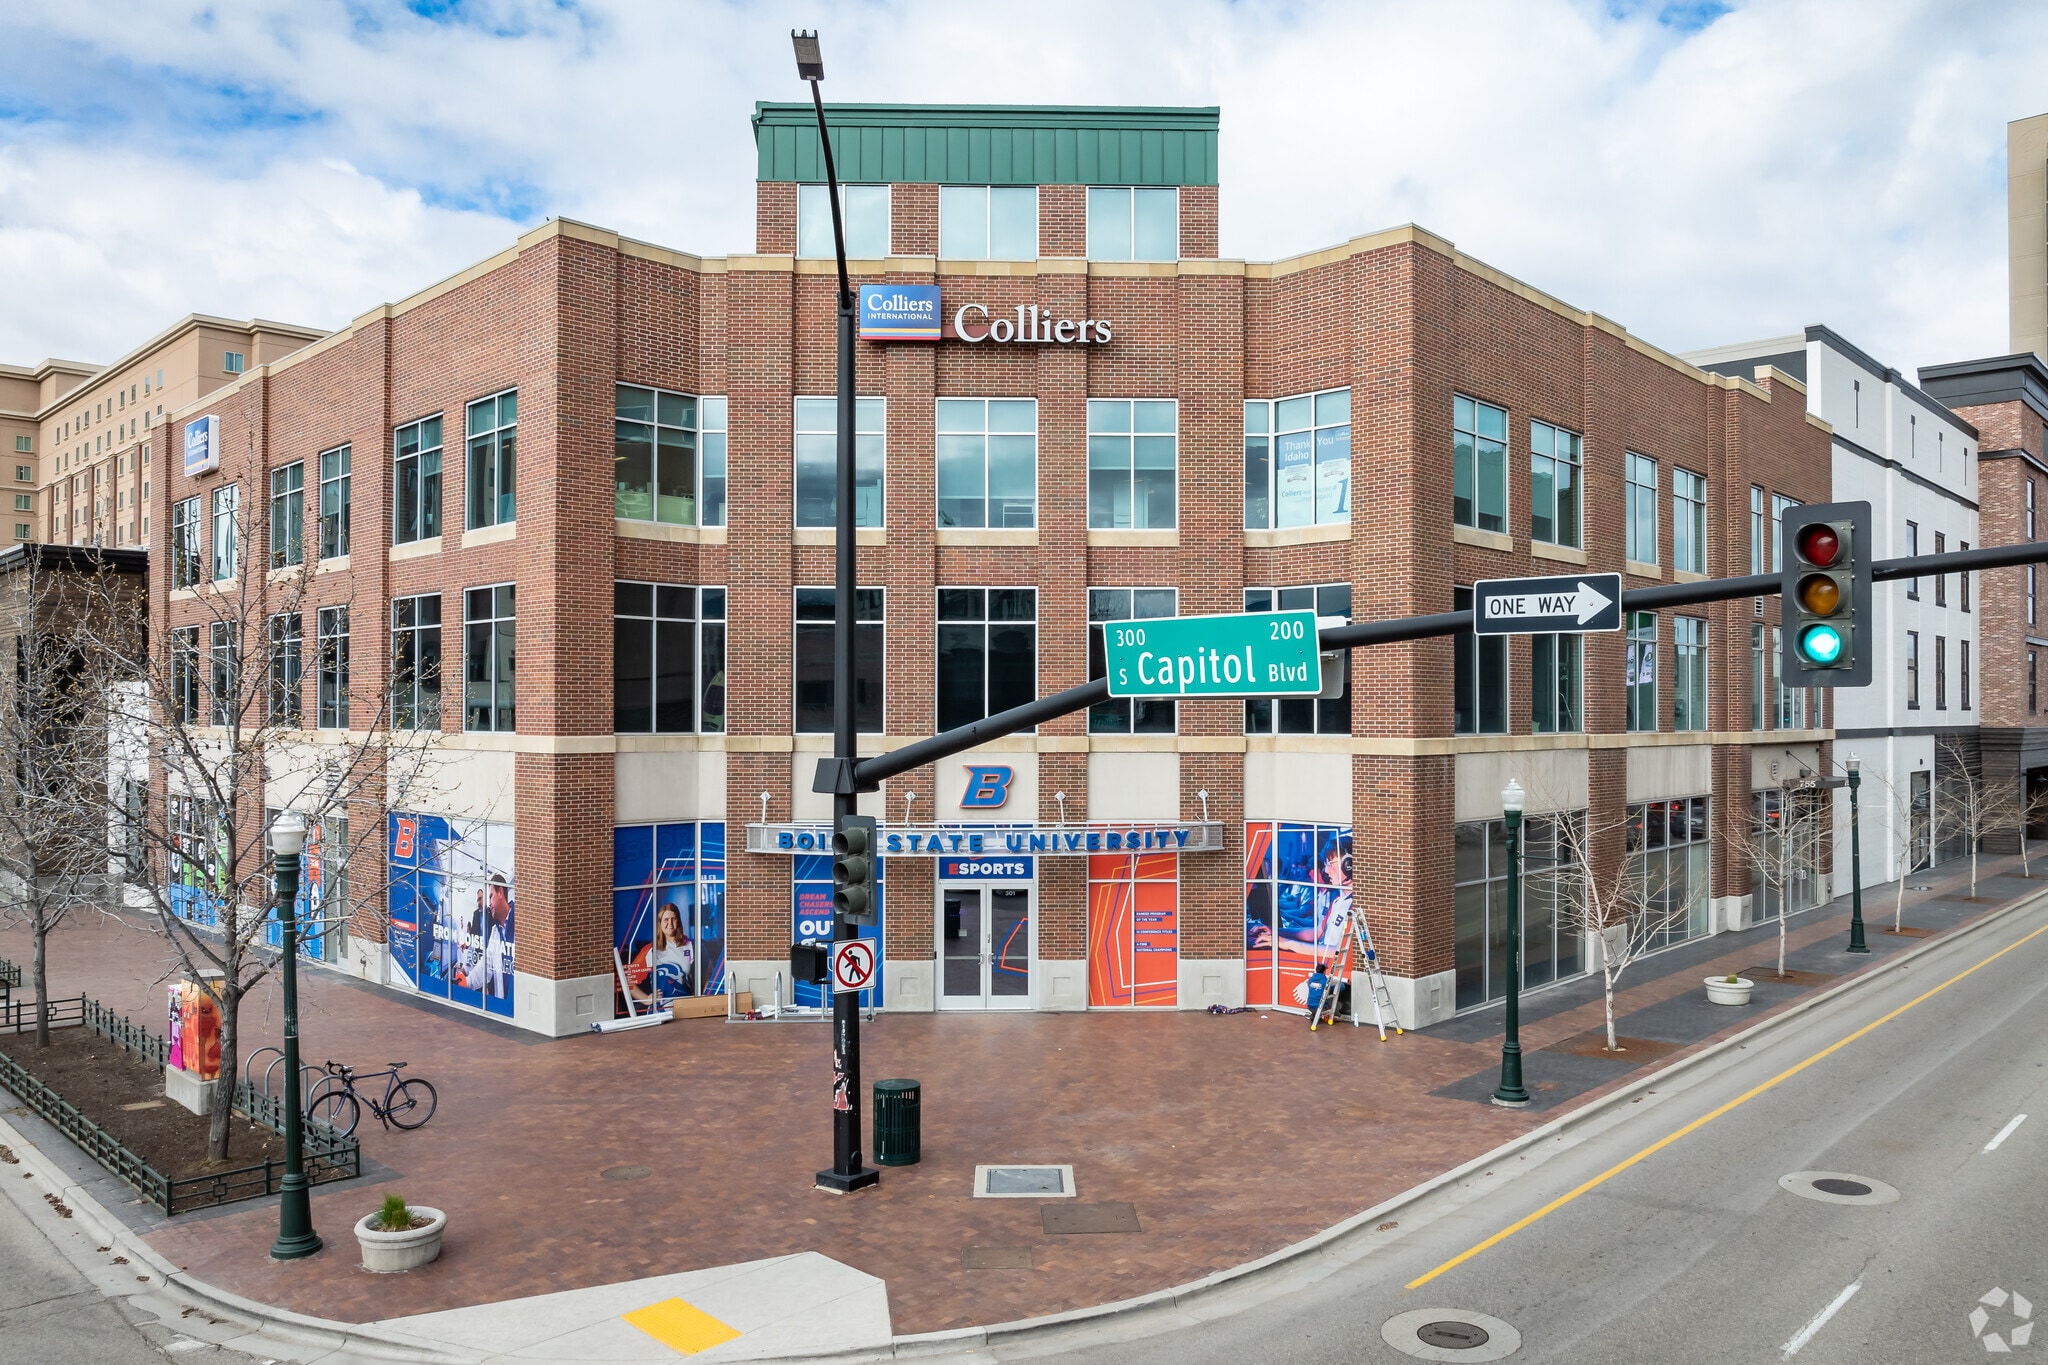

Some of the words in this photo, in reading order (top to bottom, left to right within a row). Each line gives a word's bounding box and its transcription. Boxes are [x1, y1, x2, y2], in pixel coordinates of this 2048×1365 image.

[867, 293, 933, 312] Colliers
[954, 303, 1112, 344] Colliers
[187, 429, 208, 449] Colliers
[1285, 439, 1312, 451] Thank
[1316, 436, 1334, 446] You
[1285, 451, 1309, 462] Idaho
[1490, 597, 1526, 615] ONE
[1538, 595, 1576, 614] WAY
[1115, 628, 1146, 647] 300
[1269, 620, 1304, 641] 200
[1119, 668, 1128, 686] S
[1137, 645, 1256, 694] Capitol
[1268, 662, 1308, 683] Blvd
[959, 764, 1015, 809] B
[1799, 780, 1816, 788] 755
[394, 817, 416, 859] B
[778, 831, 826, 850] BOI
[887, 832, 985, 852] STATE
[1005, 829, 1190, 851] UNIVERSITY
[948, 862, 1025, 875] ESPORTS
